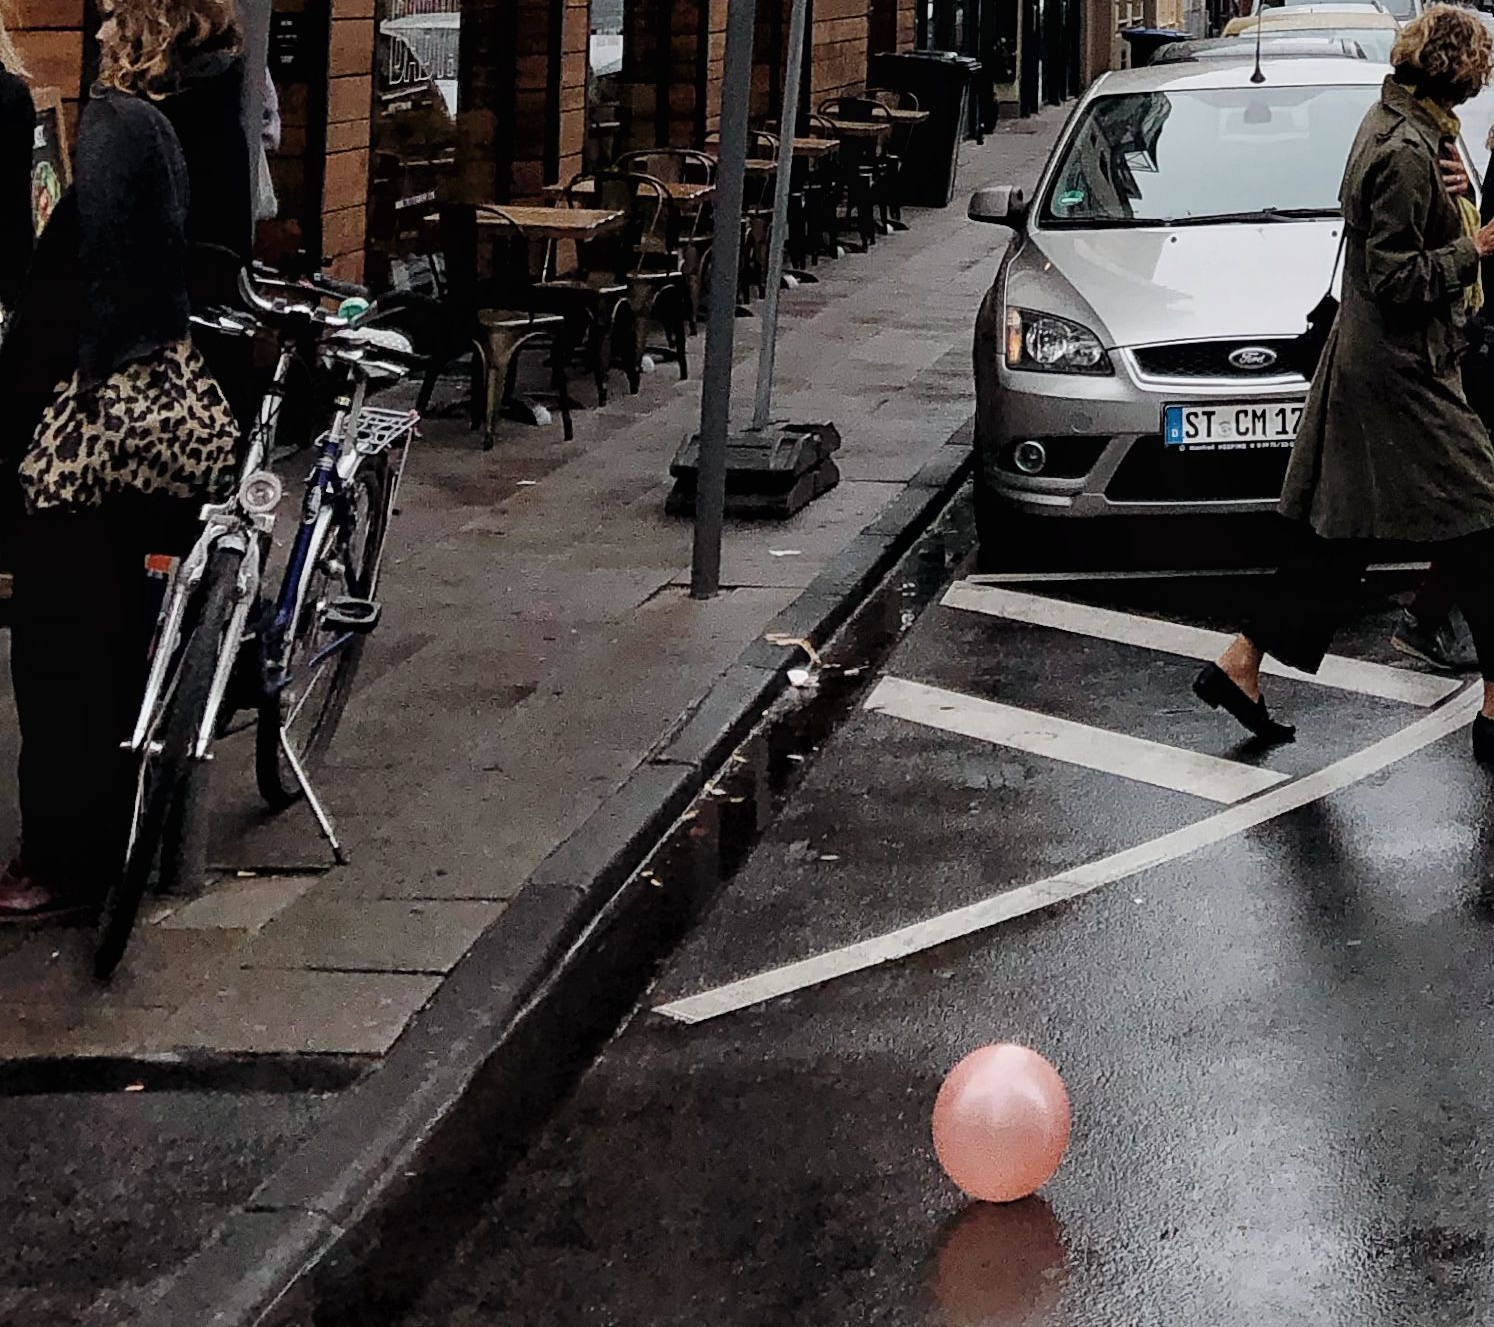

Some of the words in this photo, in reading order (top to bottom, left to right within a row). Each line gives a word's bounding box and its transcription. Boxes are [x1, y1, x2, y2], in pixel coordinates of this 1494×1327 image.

[1238, 350, 1264, 364] Ford
[1185, 411, 1214, 438] ST
[1234, 408, 1267, 439] CM
[1171, 428, 1179, 438] D
